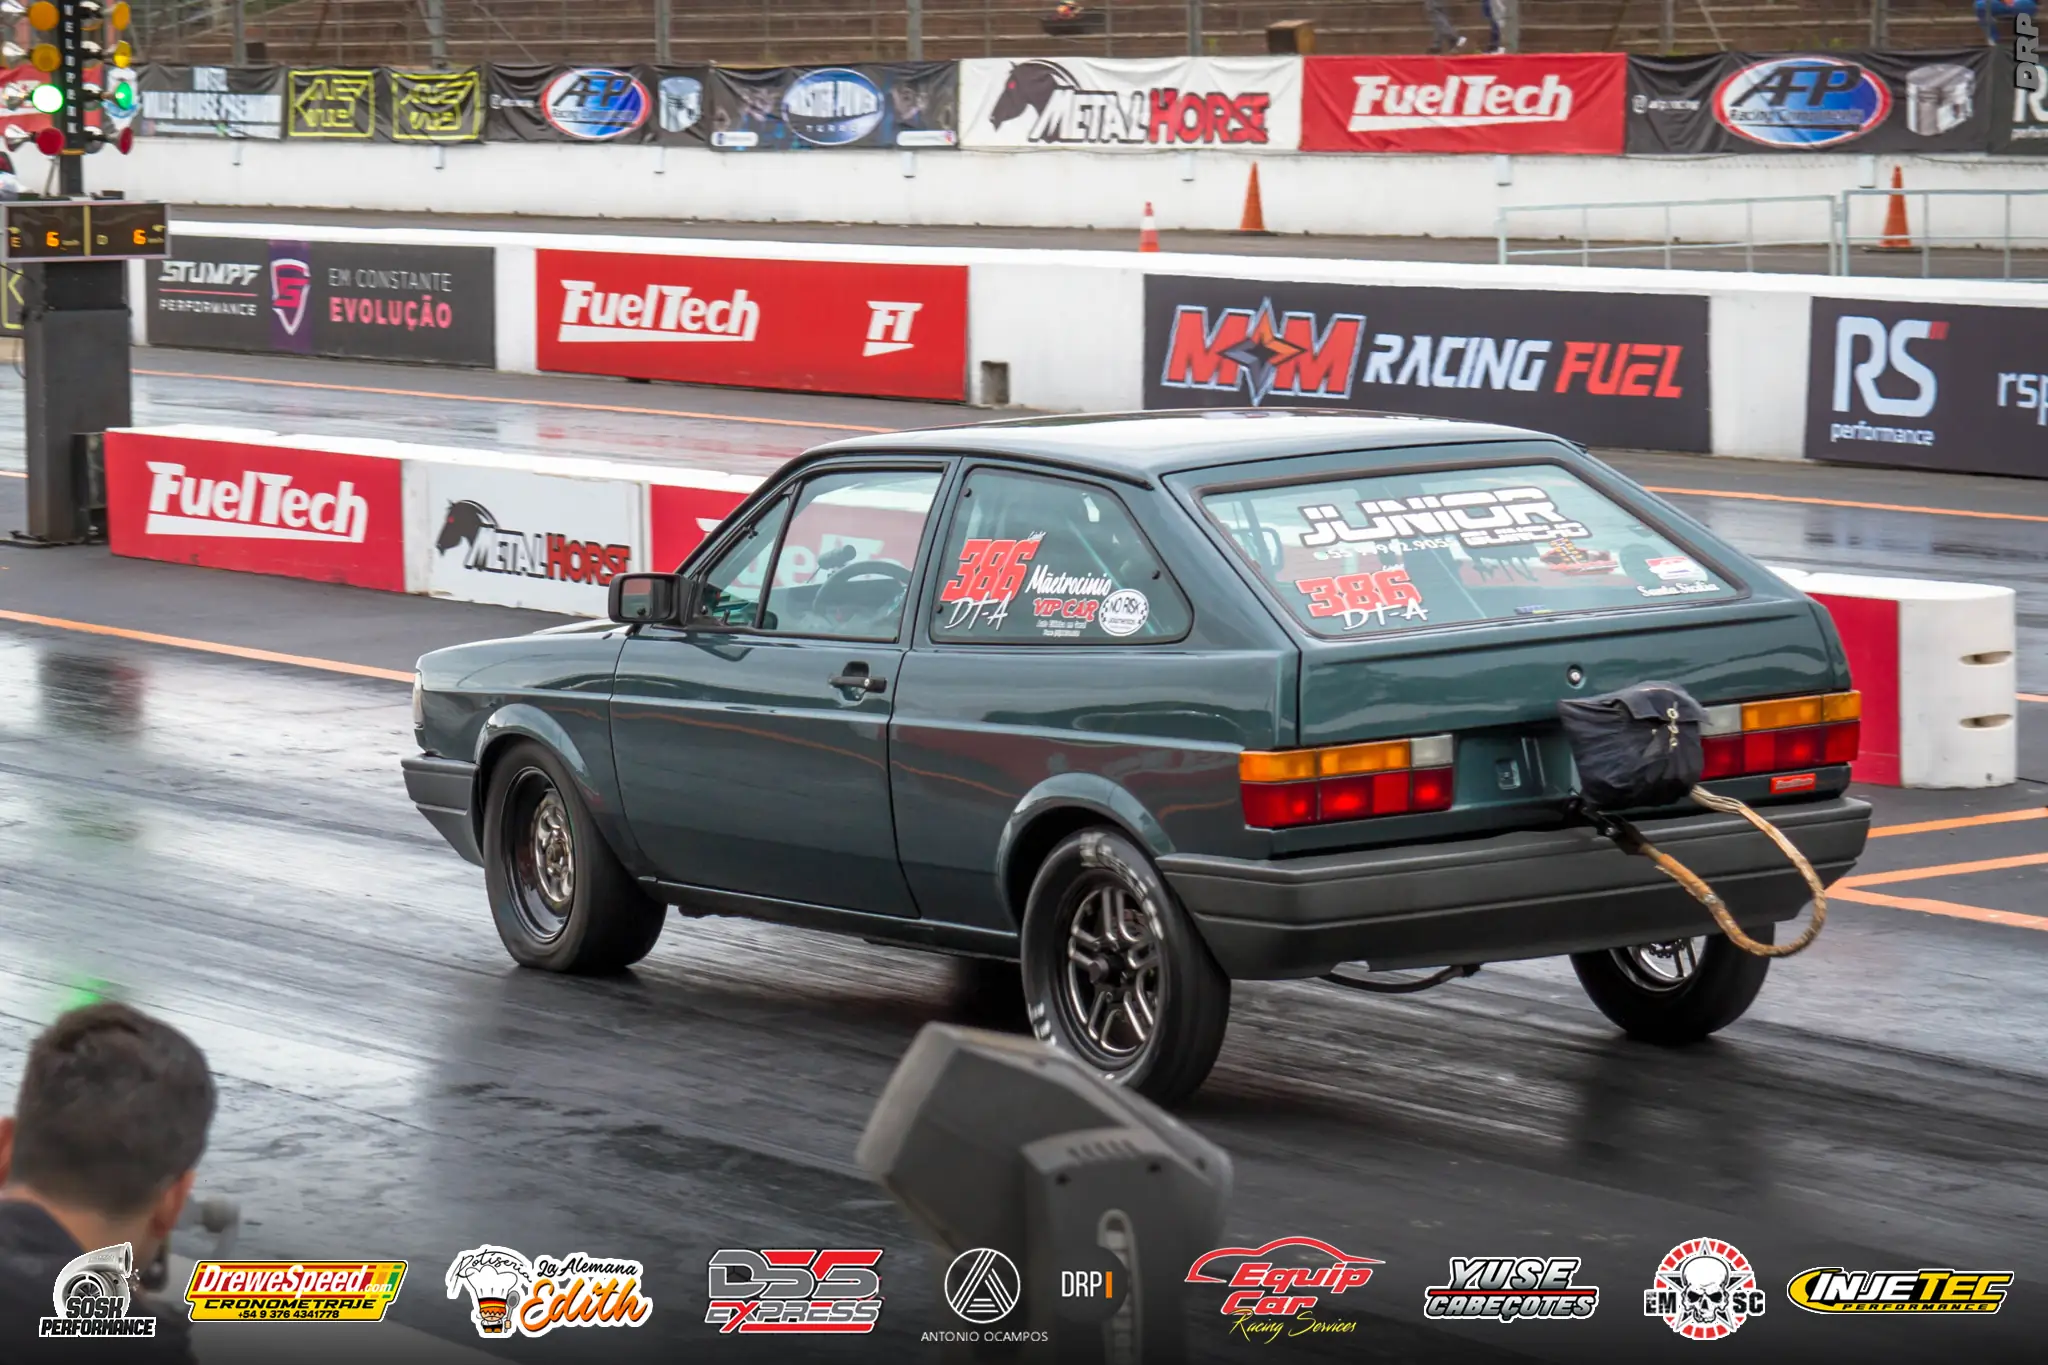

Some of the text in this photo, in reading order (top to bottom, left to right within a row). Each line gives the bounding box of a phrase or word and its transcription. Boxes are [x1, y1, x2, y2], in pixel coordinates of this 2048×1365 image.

[1348, 74, 1573, 132] FuelTech
[46, 231, 60, 247] 6
[133, 229, 147, 245] 6
[158, 261, 262, 286] STUMPF
[329, 268, 452, 292] EM CONSTANTE
[158, 298, 258, 317] PERFORMANCE
[329, 295, 453, 331] EVOLUÇÃO
[558, 279, 760, 342] FuelTech
[862, 301, 924, 357] FT
[1363, 334, 1552, 392] RACING
[1554, 341, 1684, 399] FUEL
[1832, 316, 1950, 418] RS
[1830, 421, 1935, 446] performance
[145, 461, 369, 543] FuelTech
[1299, 486, 1567, 547] JUNIOR
[940, 539, 1041, 602] 386
[1295, 570, 1422, 617] 386
[1032, 598, 1100, 623] VIP CAR
